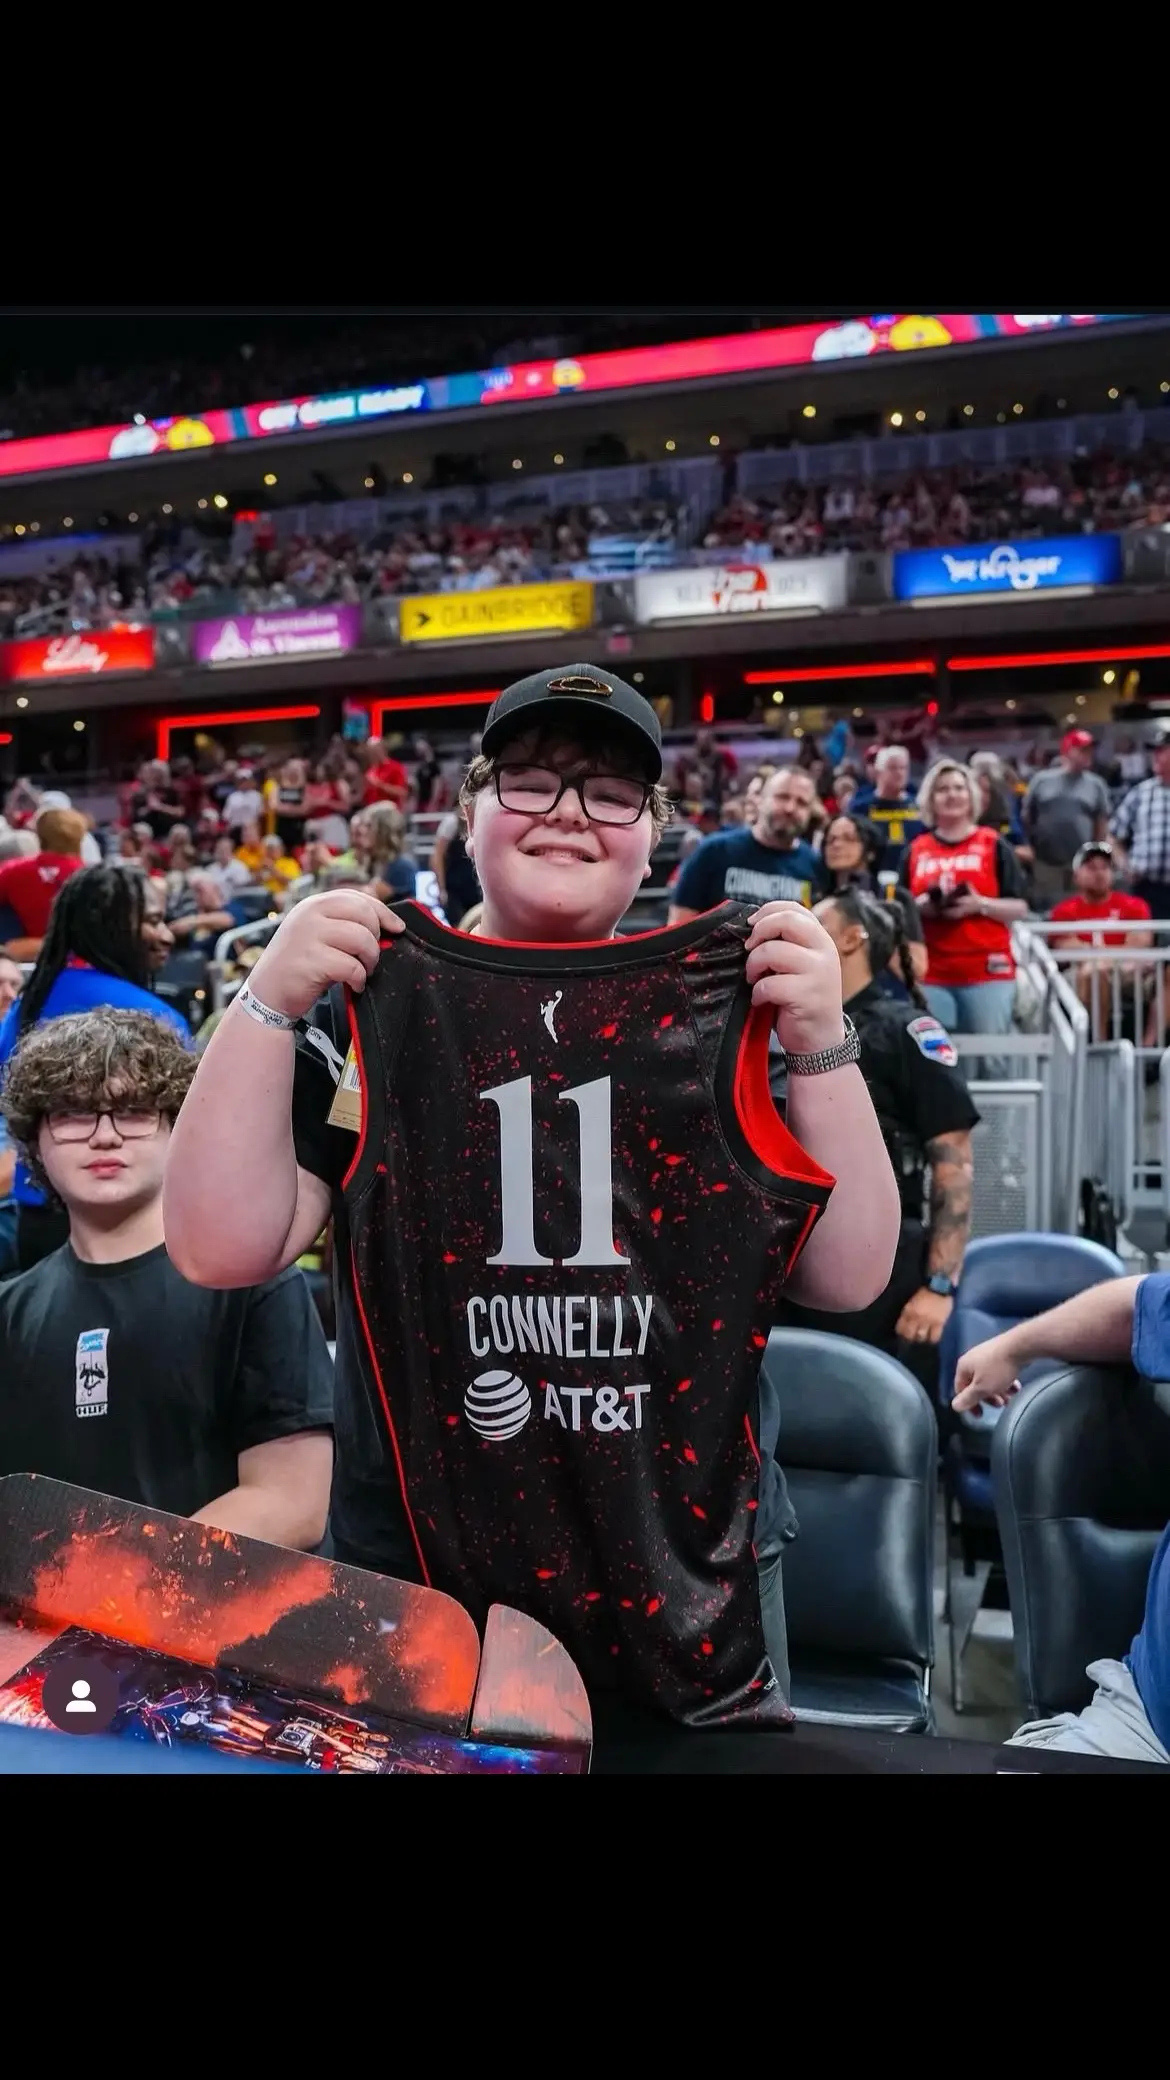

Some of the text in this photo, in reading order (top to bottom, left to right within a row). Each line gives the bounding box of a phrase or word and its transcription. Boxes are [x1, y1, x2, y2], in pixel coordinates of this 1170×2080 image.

[479, 1074, 631, 1266] 11
[466, 1294, 653, 1358] CONNELLY
[76, 1403, 108, 1418] HUF
[543, 1382, 651, 1433] AT&T
